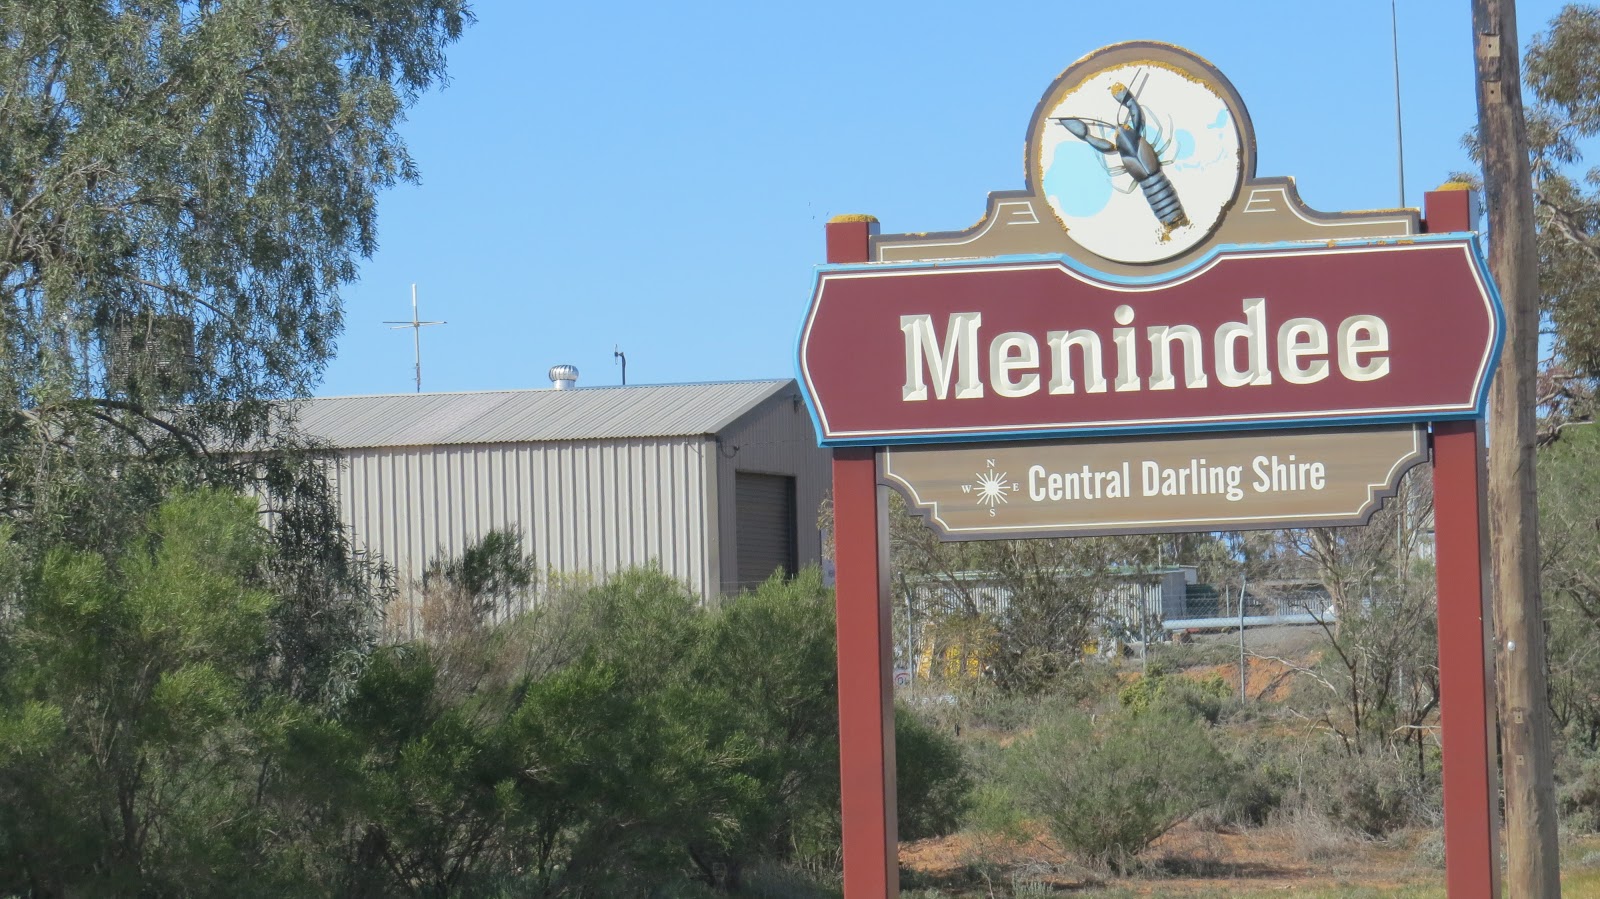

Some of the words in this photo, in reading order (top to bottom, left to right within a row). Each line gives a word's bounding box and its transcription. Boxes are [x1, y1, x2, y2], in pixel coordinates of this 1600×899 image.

[899, 297, 1391, 402] Menindee
[986, 458, 996, 469] N
[1028, 461, 1131, 502] Central
[1141, 458, 1244, 502] Darling
[1251, 454, 1326, 494] Shire
[961, 484, 973, 494] W
[1011, 482, 1021, 493] E
[988, 508, 997, 519] S
